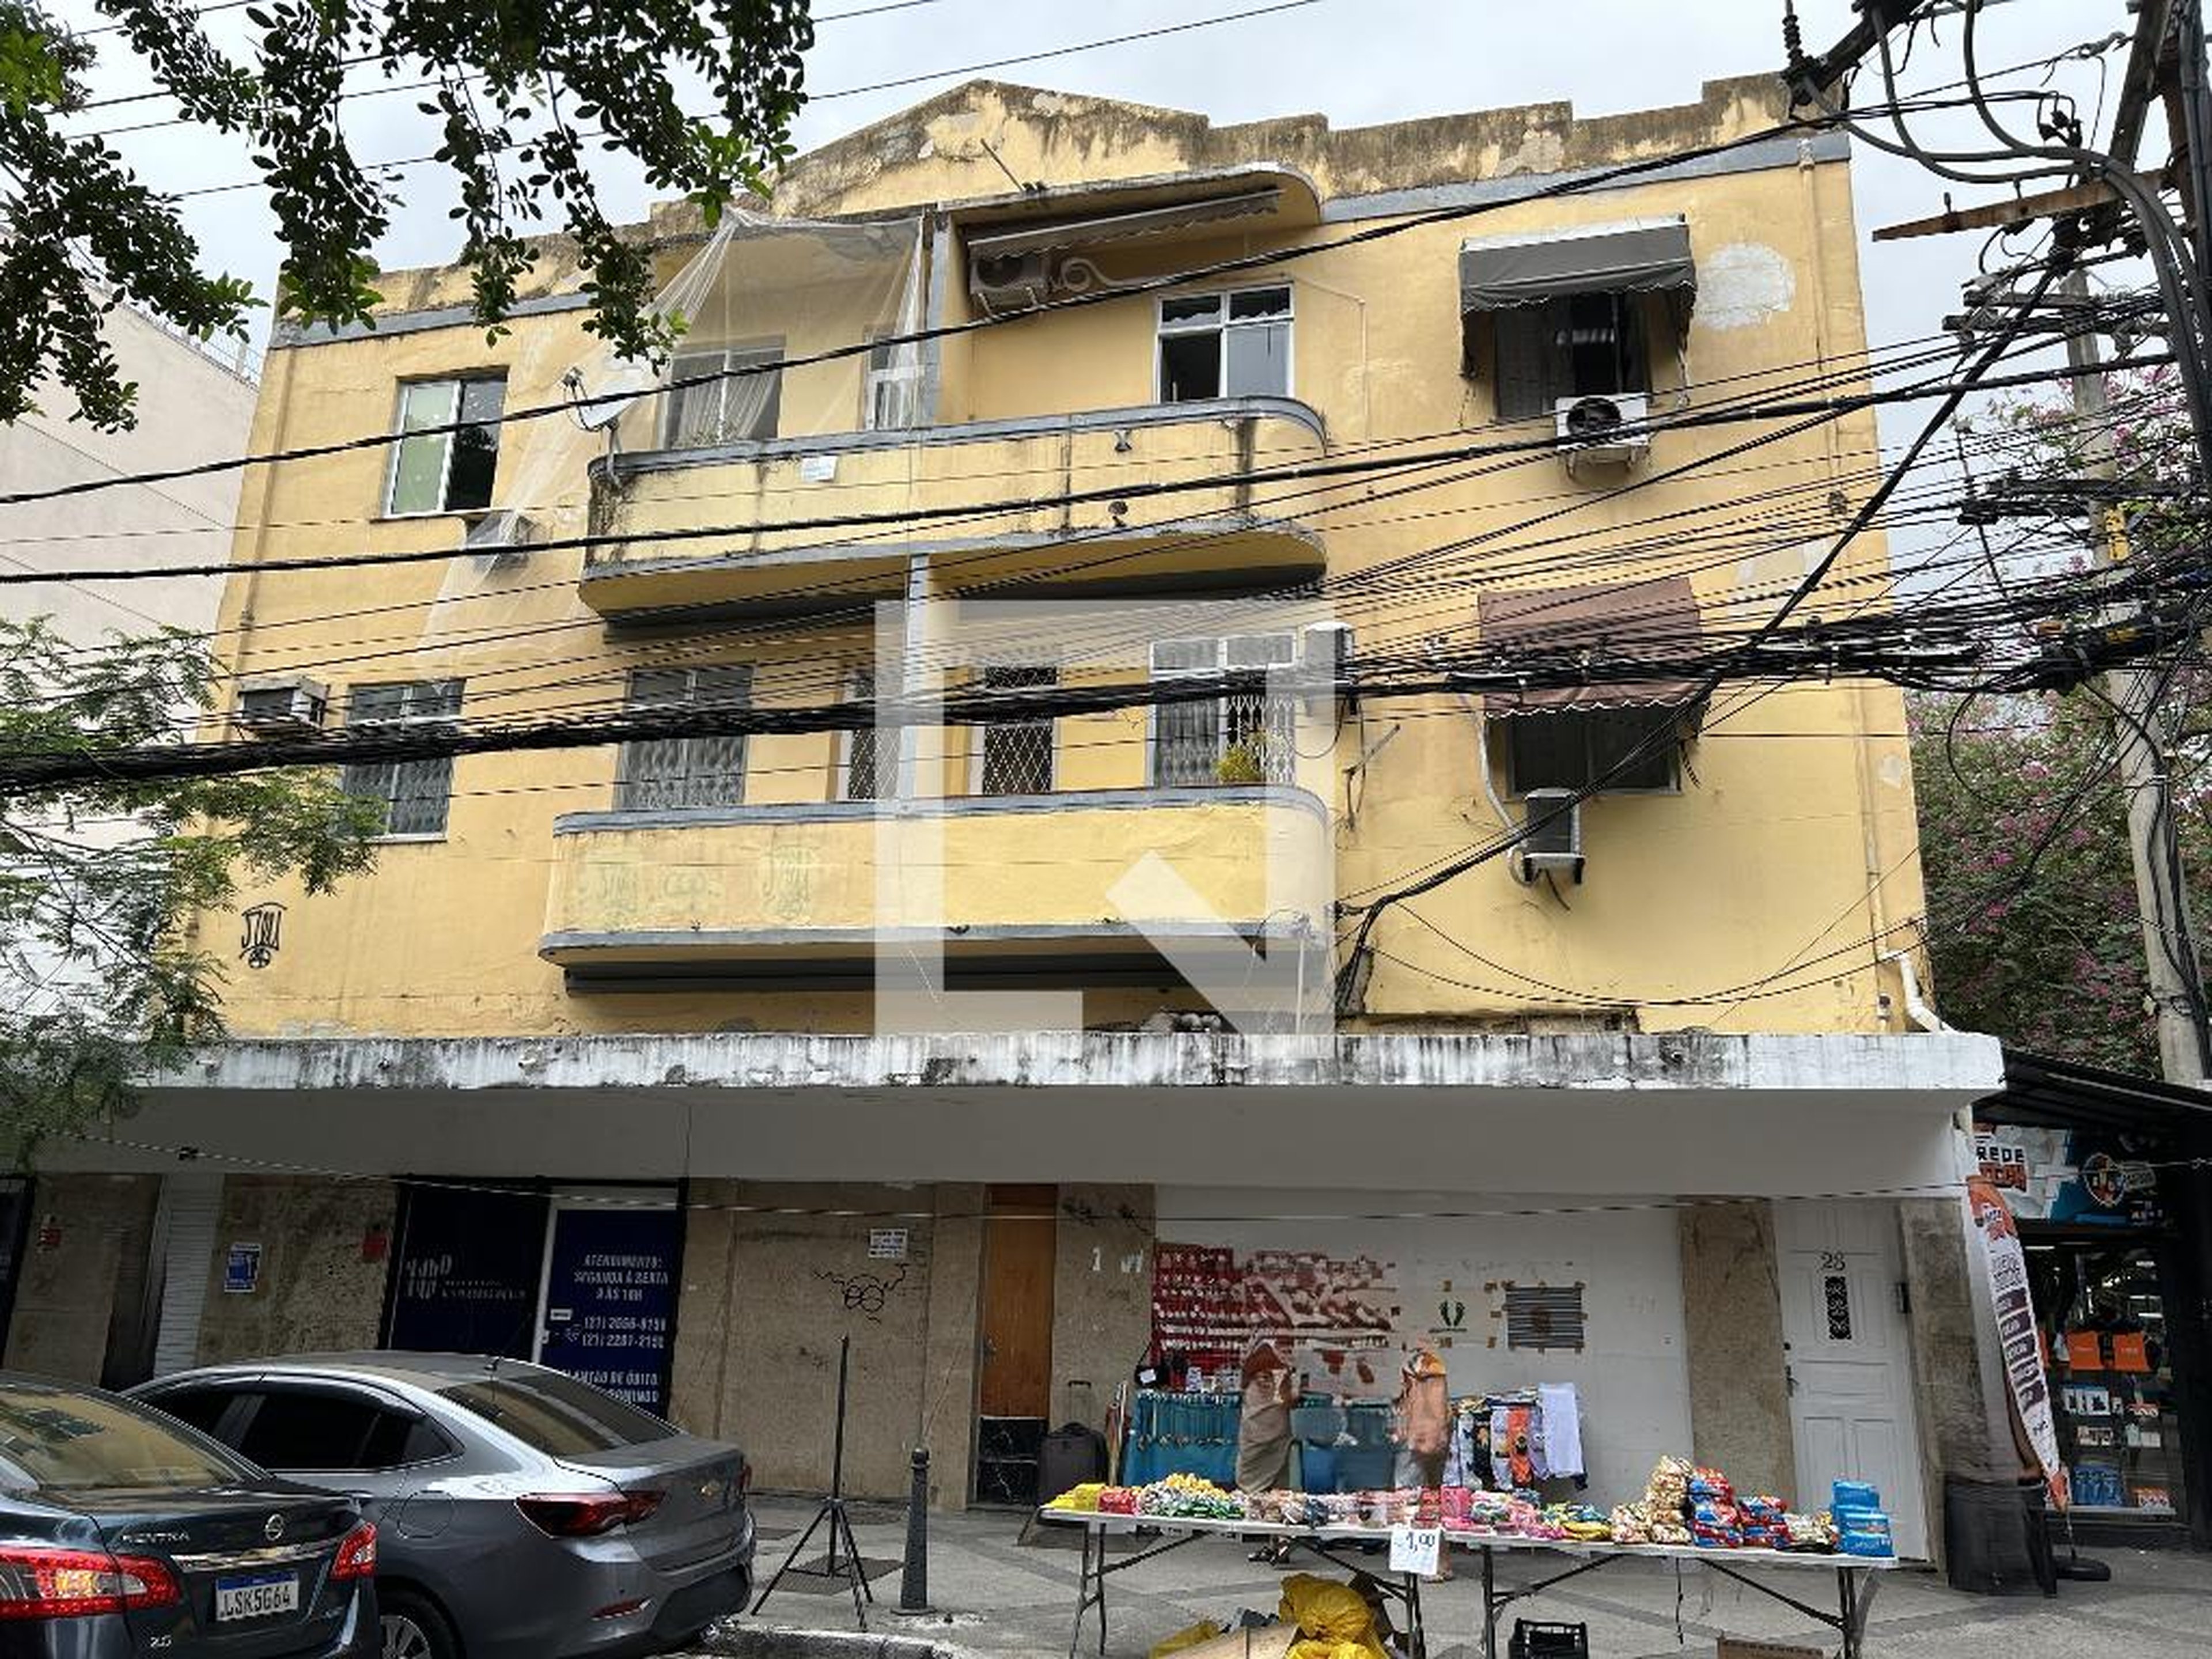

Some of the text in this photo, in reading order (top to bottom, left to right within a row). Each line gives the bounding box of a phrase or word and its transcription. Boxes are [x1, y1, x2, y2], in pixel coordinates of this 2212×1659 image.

[1976, 1146, 2025, 1162] REDE
[1819, 1251, 1846, 1271] 28
[222, 1585, 291, 1617] LSK5G64
